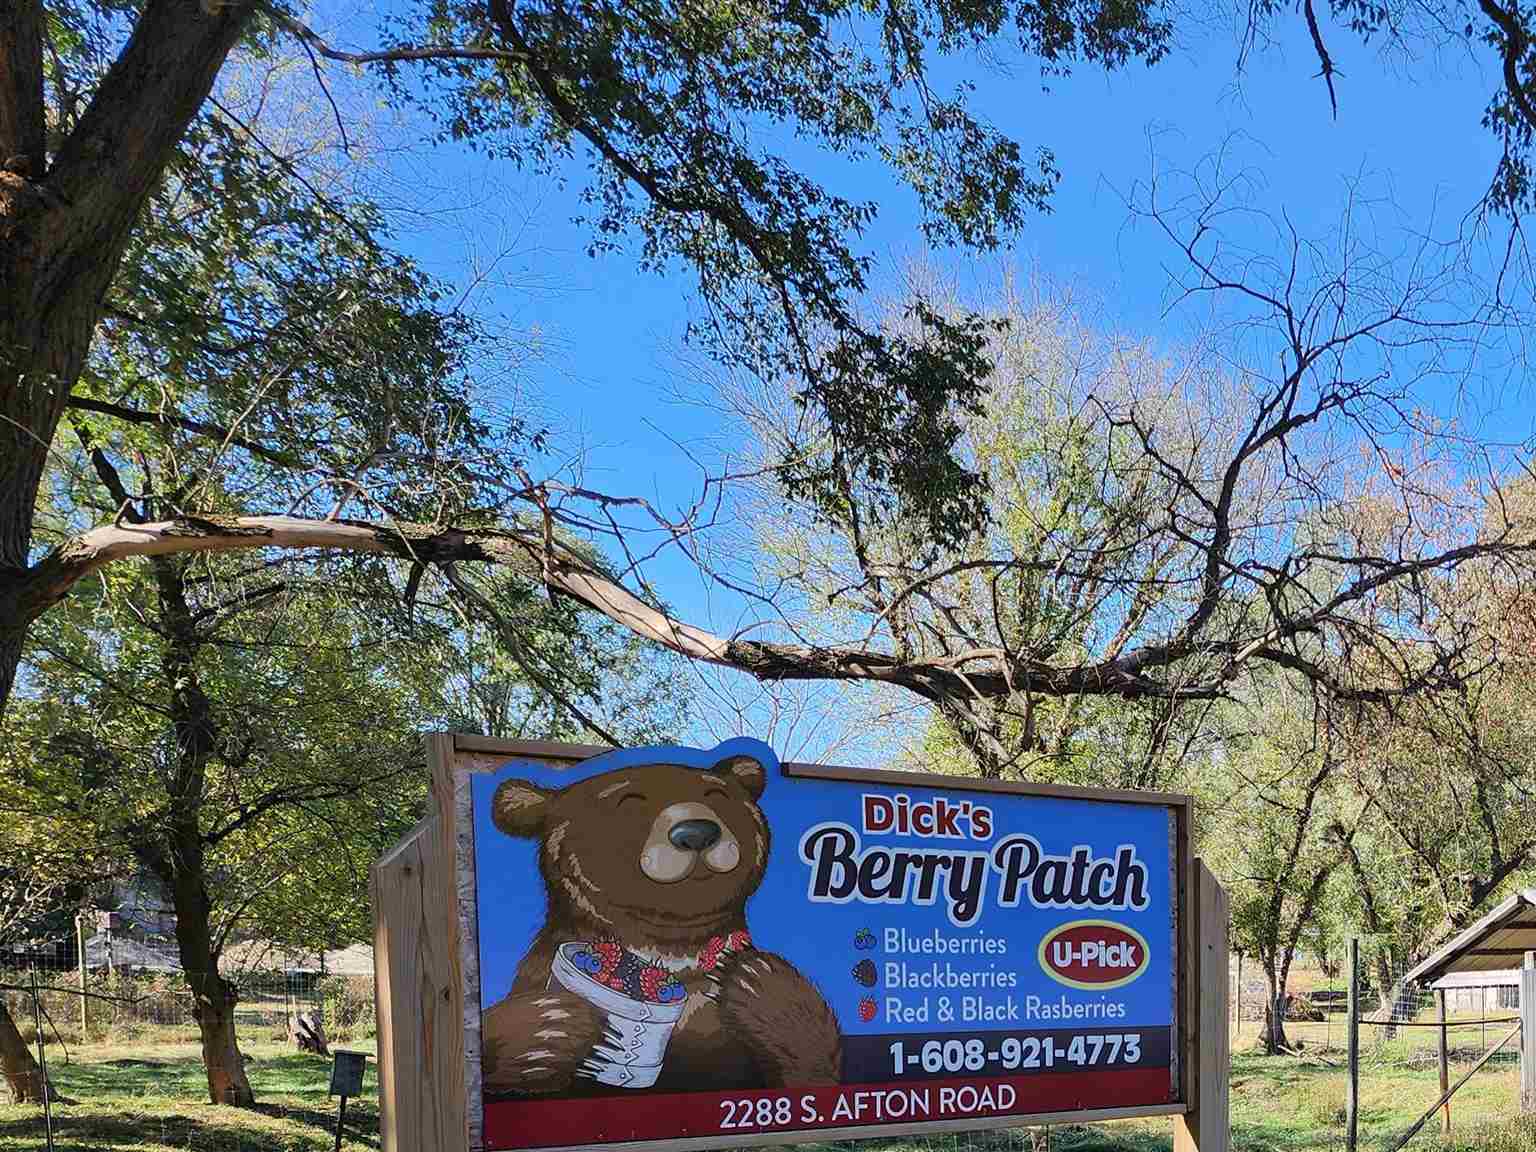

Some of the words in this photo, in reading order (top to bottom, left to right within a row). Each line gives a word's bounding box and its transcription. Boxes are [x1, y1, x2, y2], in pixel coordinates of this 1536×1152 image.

[862, 795, 992, 839] Dick's
[802, 824, 988, 925] Berry
[993, 836, 1149, 909] Patch
[884, 927, 1007, 954] Blueberries
[1052, 940, 1137, 968] U-Pick
[885, 961, 1017, 988] Blackberries
[885, 997, 929, 1023] Red
[938, 996, 955, 1022] &
[962, 995, 1018, 1022] Black
[1026, 995, 1126, 1020] Rasberries
[889, 1033, 1142, 1075] 1-608-921-4773
[720, 1097, 792, 1129] 2288
[800, 1095, 825, 1124] S.
[831, 1088, 930, 1121] AFTON
[940, 1083, 1017, 1114] ROAD
